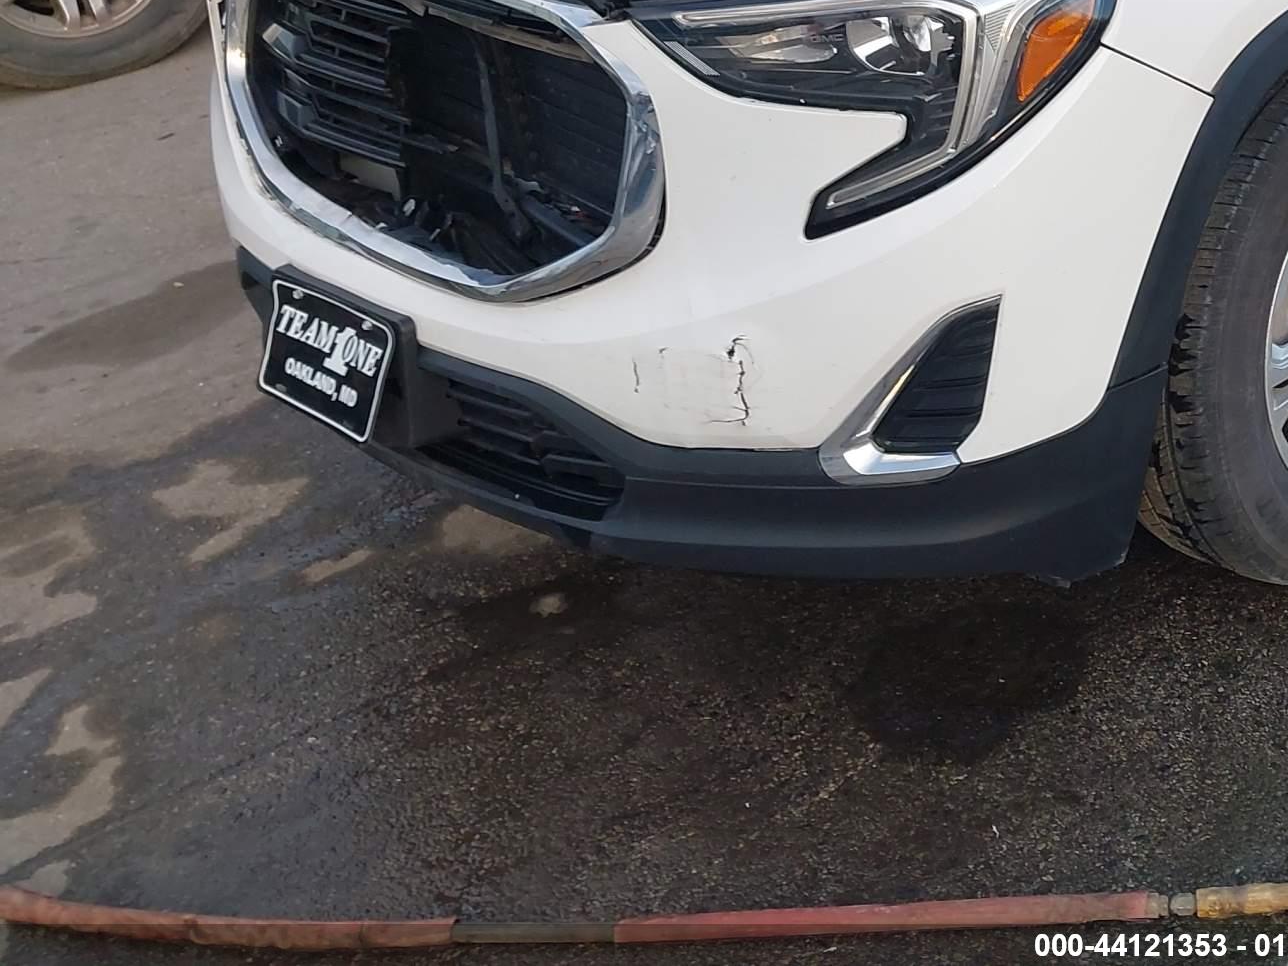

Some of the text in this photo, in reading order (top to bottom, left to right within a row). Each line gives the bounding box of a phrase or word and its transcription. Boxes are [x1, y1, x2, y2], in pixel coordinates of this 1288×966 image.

[276, 304, 340, 354] TEAM
[342, 333, 384, 378] ONE
[284, 356, 358, 408] OAKLAND, MD
